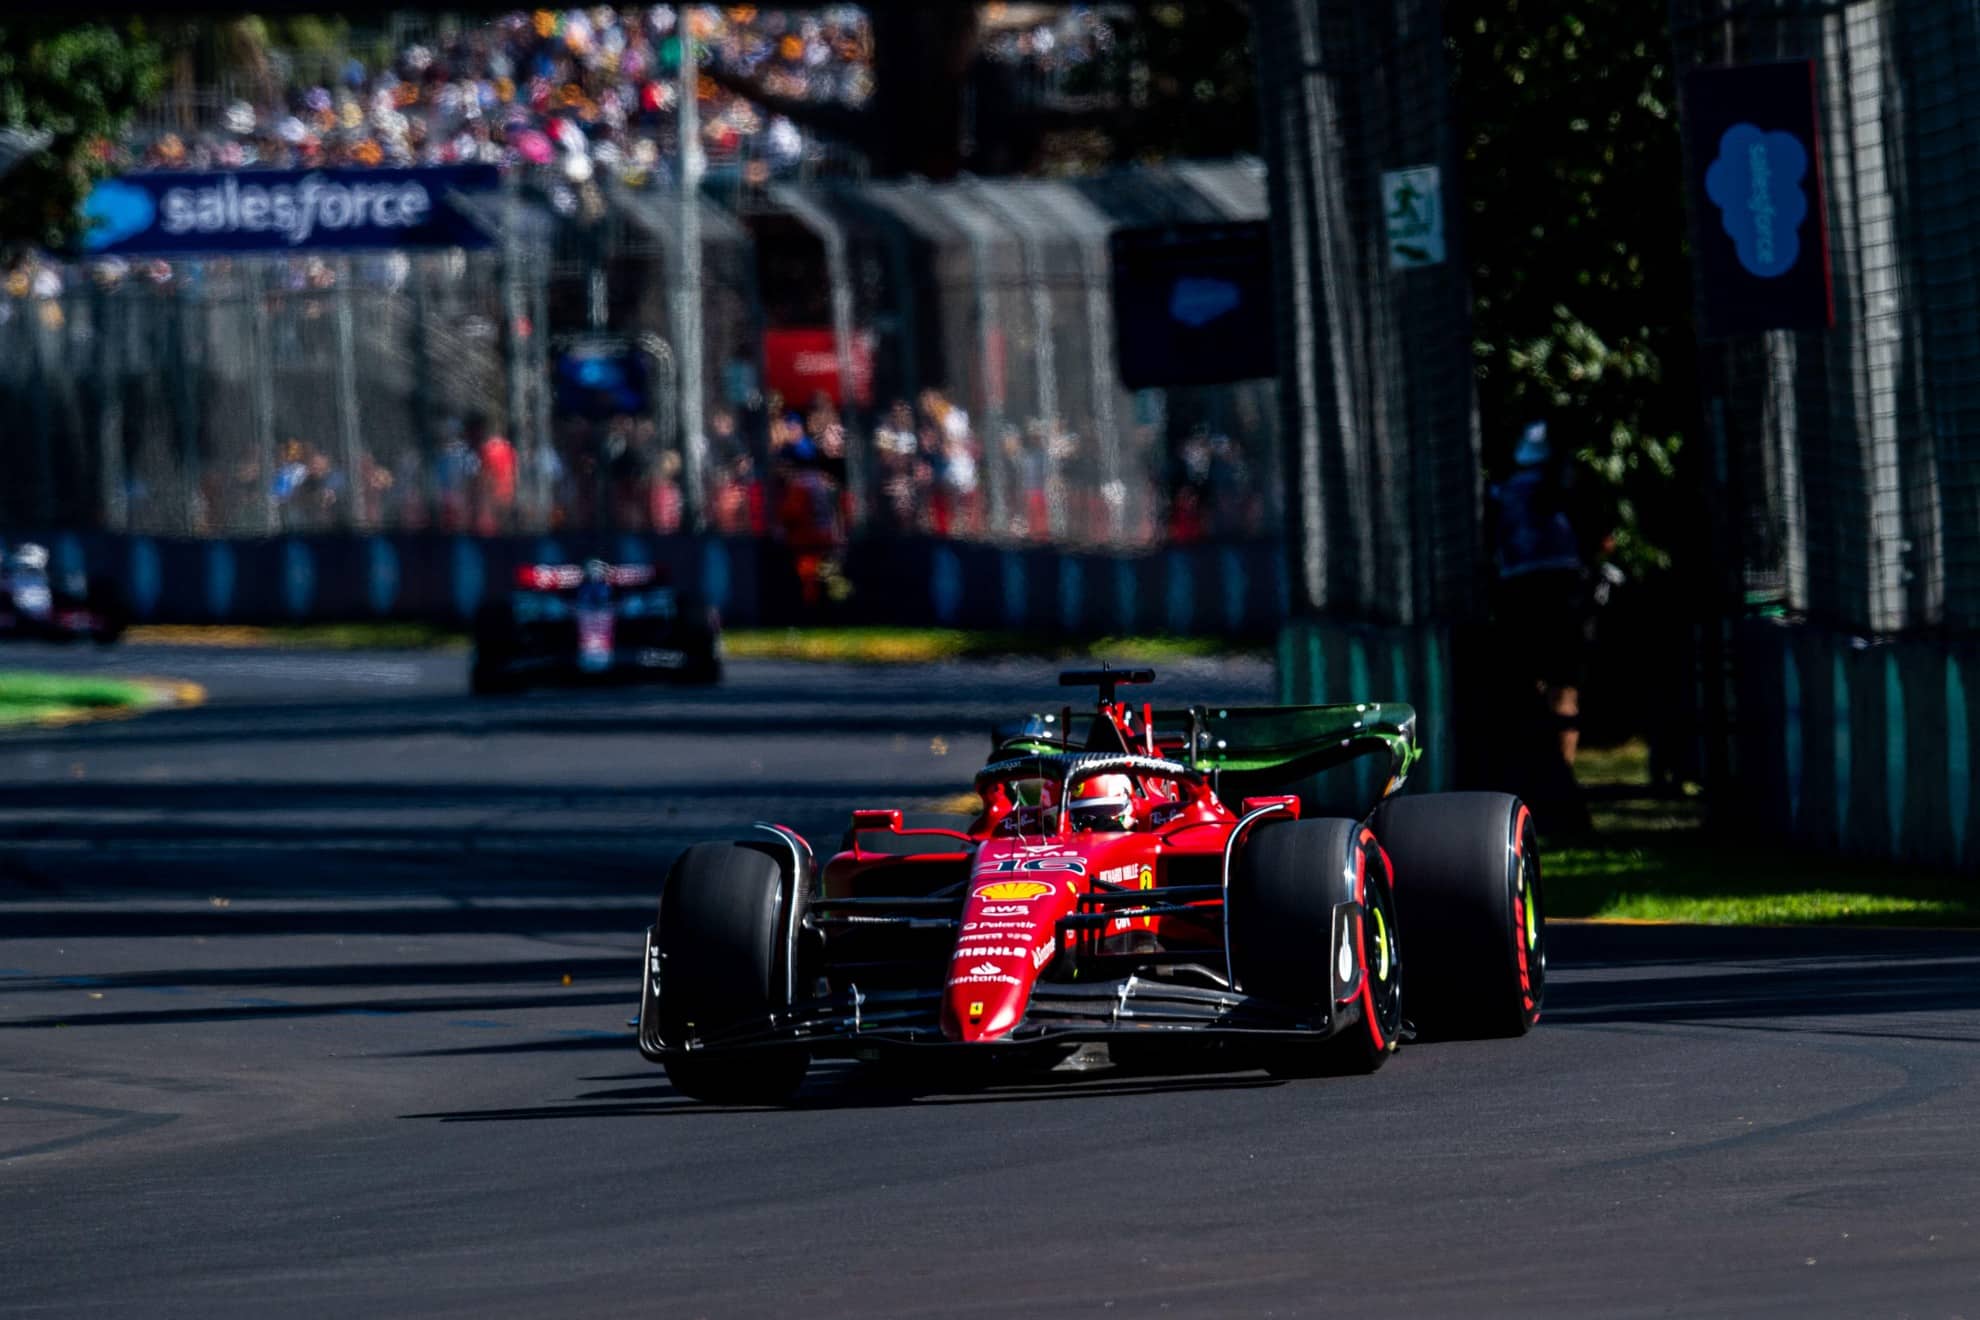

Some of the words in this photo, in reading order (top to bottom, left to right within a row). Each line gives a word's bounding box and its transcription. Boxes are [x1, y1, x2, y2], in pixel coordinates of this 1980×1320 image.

[160, 171, 430, 245] salesforce
[1749, 144, 1774, 264] salesforce
[974, 857, 1088, 876] 16
[979, 921, 1037, 929] Palantir
[953, 946, 1026, 960] MAHLE
